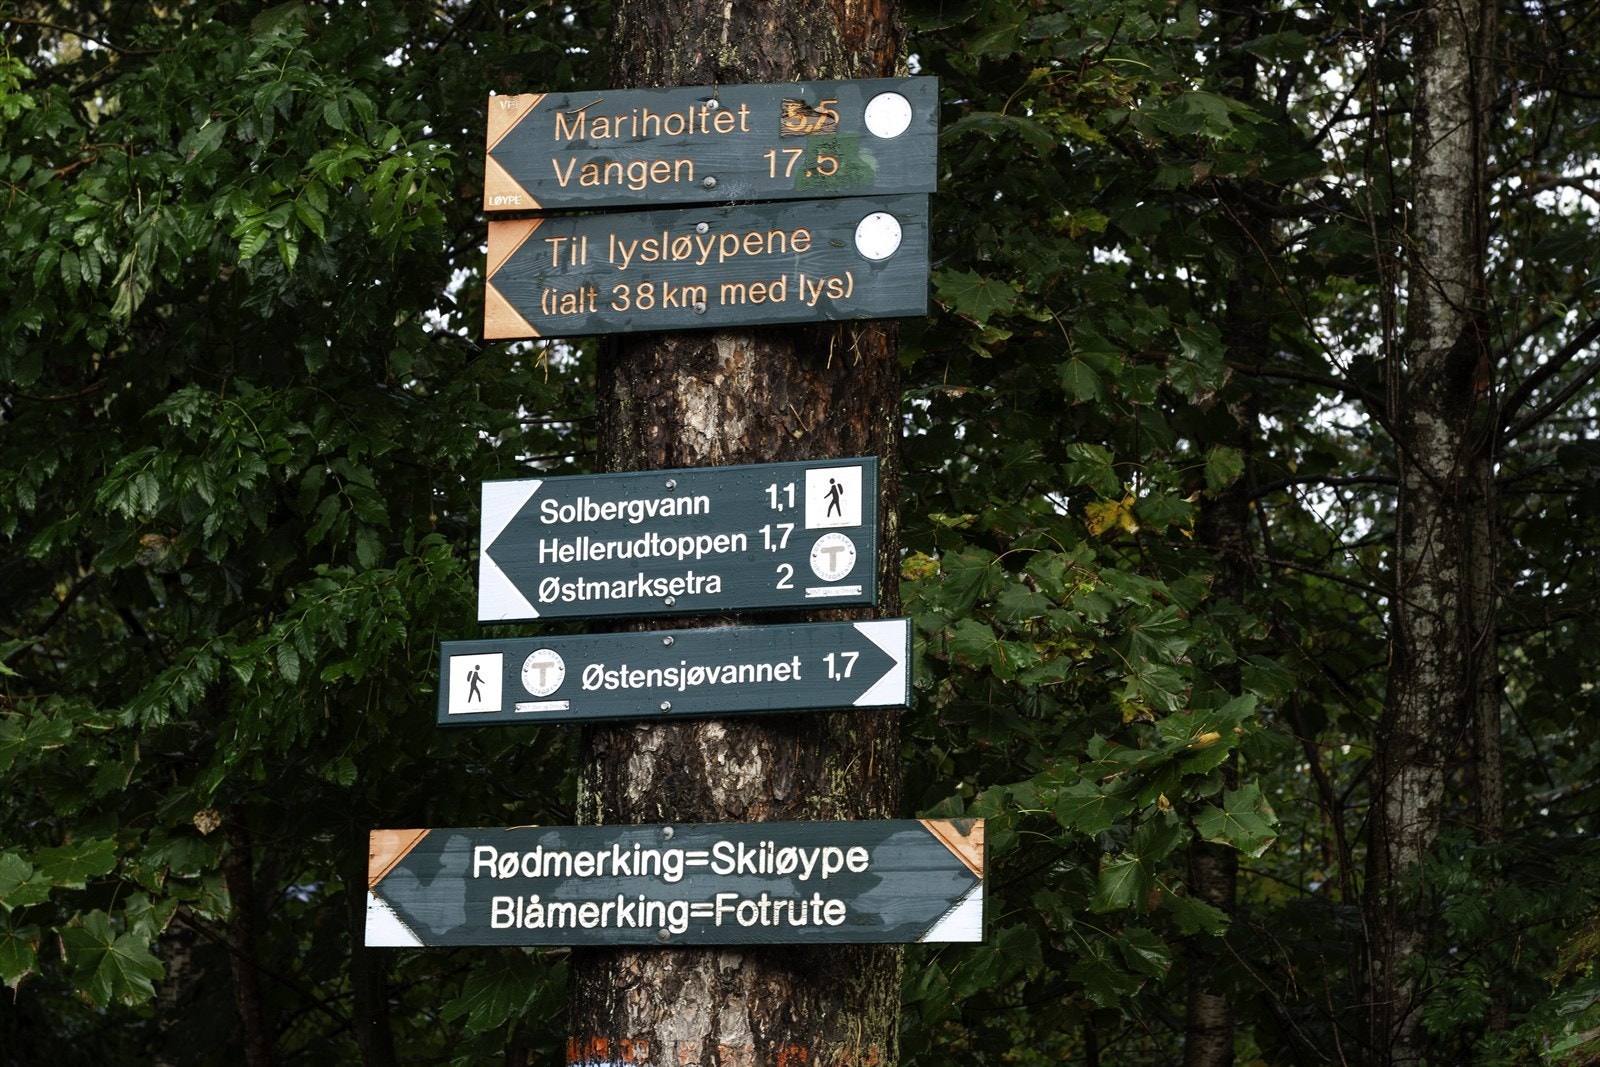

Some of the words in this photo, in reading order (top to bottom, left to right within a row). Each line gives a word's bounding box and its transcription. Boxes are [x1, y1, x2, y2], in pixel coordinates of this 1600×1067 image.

[554, 102, 751, 142] Mariholtet
[552, 155, 695, 191] Vangen
[488, 195, 522, 206] LØYPE
[544, 235, 588, 267] Til
[609, 228, 812, 271] lysløypene
[541, 284, 598, 315] (ialt
[720, 274, 787, 306] med
[800, 270, 854, 307] lys)
[540, 495, 711, 524] Solbergvann
[765, 482, 795, 512] 1,1
[539, 531, 748, 564] Hellerudtoppen
[758, 522, 795, 553] 1,7
[538, 570, 722, 603] Østmarksetra
[776, 563, 794, 589] 2
[581, 655, 802, 692] Østensjøvannet
[822, 651, 860, 681] 1,7
[473, 840, 869, 883] Rødmerking=Skiløype
[491, 892, 847, 935] Blåmerking=Fotrute
